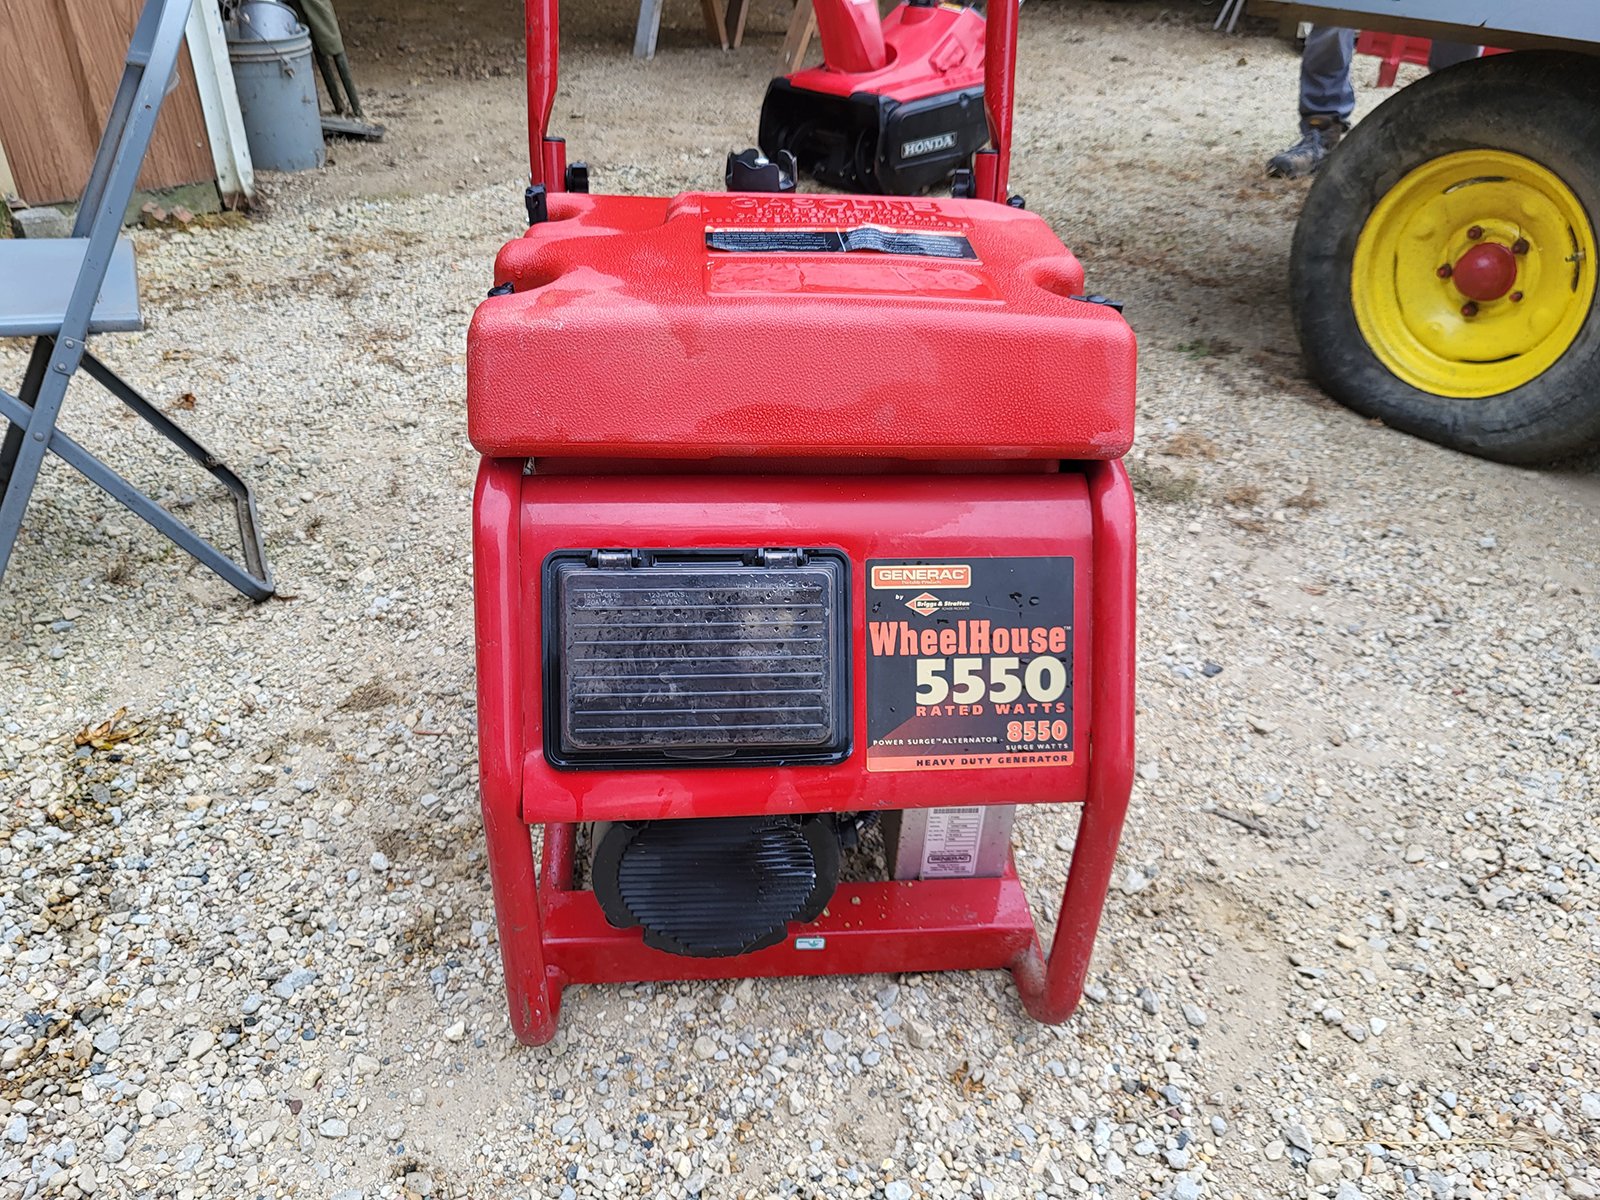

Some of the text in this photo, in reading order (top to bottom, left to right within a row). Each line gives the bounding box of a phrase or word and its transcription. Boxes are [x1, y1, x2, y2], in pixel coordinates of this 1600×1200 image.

[903, 135, 954, 157] HONDA
[879, 569, 966, 581] GENERAC
[915, 655, 1066, 706] 5550
[916, 702, 1066, 717] RATED WATTS
[1006, 720, 1068, 742] 8550
[942, 736, 998, 744] ALTERNATOR
[916, 755, 1068, 767] HEAVY DUTY GENERATOR
